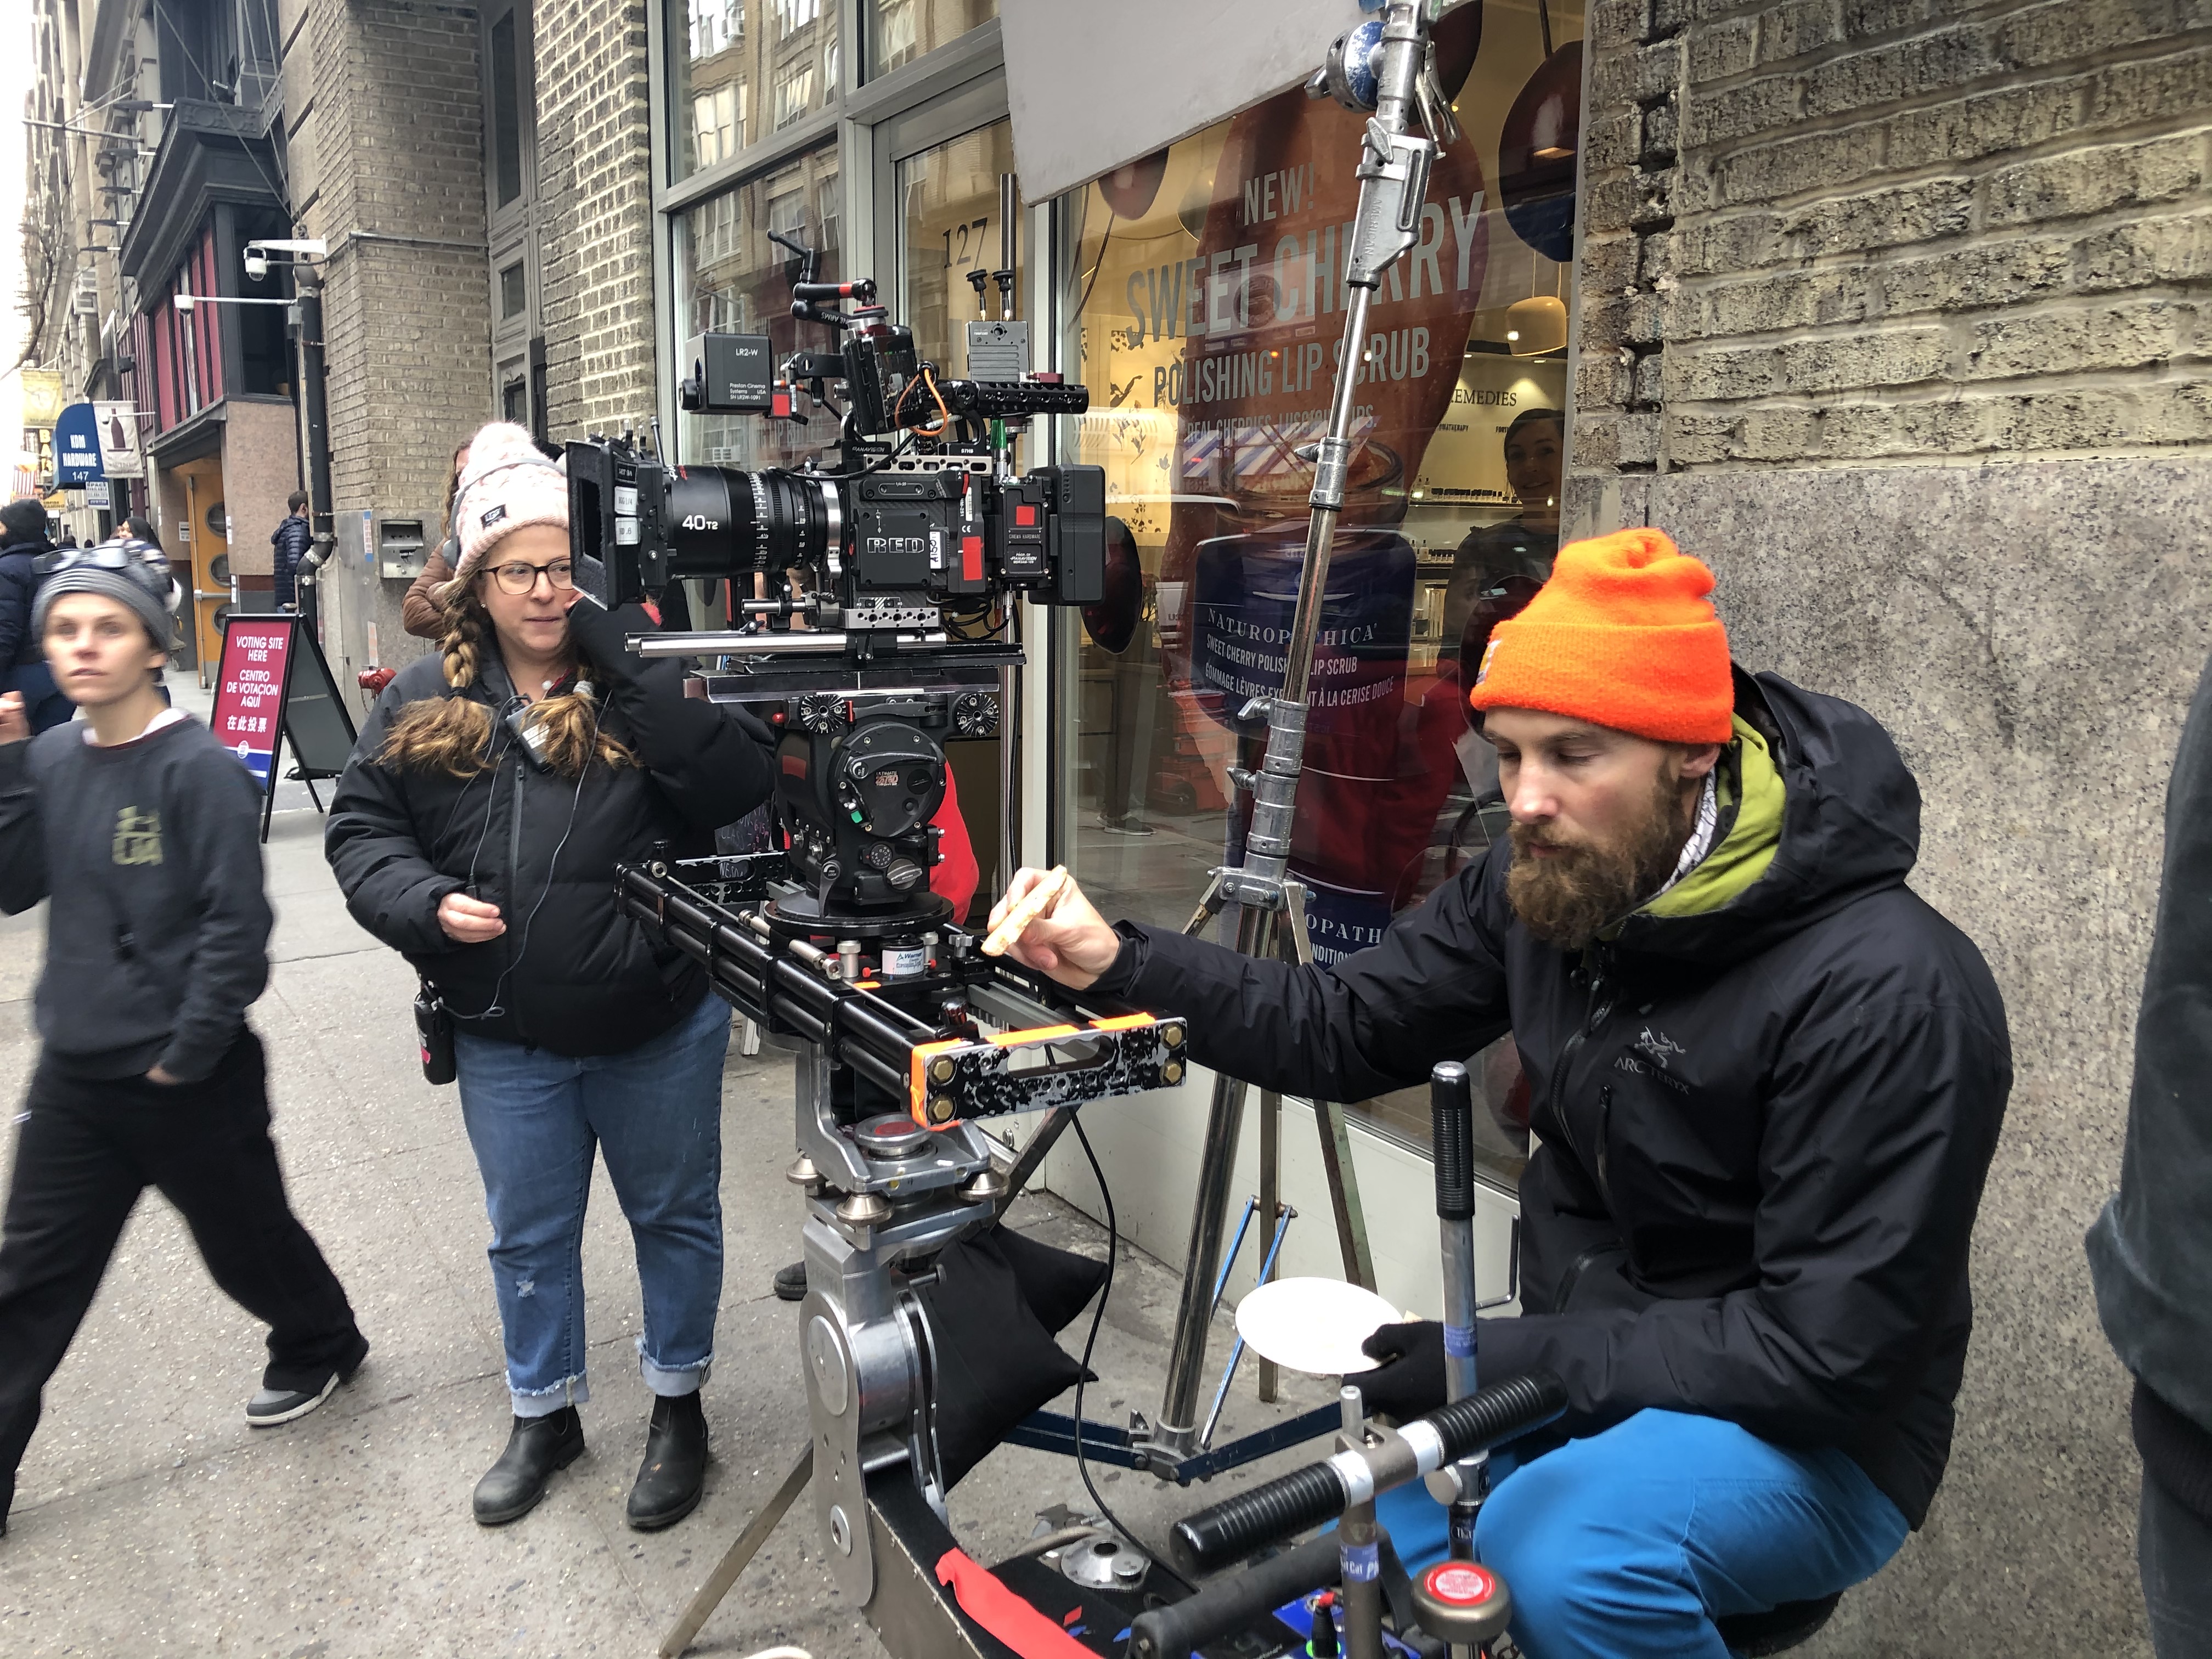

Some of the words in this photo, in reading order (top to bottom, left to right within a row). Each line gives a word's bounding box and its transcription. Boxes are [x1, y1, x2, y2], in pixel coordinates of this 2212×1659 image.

[1244, 162, 1314, 226] NEW!
[943, 217, 988, 270] 127
[1126, 243, 1258, 348] SWEET
[1154, 349, 1273, 408] POLISHING
[1282, 342, 1323, 393] LIP
[1451, 389, 1517, 407] EMEDIES
[1352, 404, 1377, 430] IPS.
[70, 434, 86, 449] KDM
[63, 453, 97, 467] HARDWARE
[72, 471, 89, 481] 147
[962, 525, 971, 533] CE
[867, 538, 924, 554] RED
[1209, 607, 1374, 646] NATUROPHICA
[236, 635, 267, 650] VOTING
[268, 636, 284, 650] SITE
[247, 650, 268, 662] HERE
[1206, 633, 1226, 657] SWEET
[1226, 642, 1257, 668] CHERRY
[1310, 658, 1324, 676] IP
[1327, 656, 1358, 675] SCRUB
[239, 669, 270, 682] CENTRO
[1205, 662, 1234, 691] GOMMAGE
[1235, 676, 1267, 698] LÈVRES
[1318, 687, 1325, 707] À
[1327, 690, 1338, 707] LA
[1340, 684, 1370, 706] CERISE
[1372, 675, 1395, 699] DOUCE
[226, 681, 236, 693] DE
[239, 682, 279, 696] VOTACION
[227, 715, 267, 733] 在此投票
[1614, 1056, 1690, 1096] ARCTERYX
